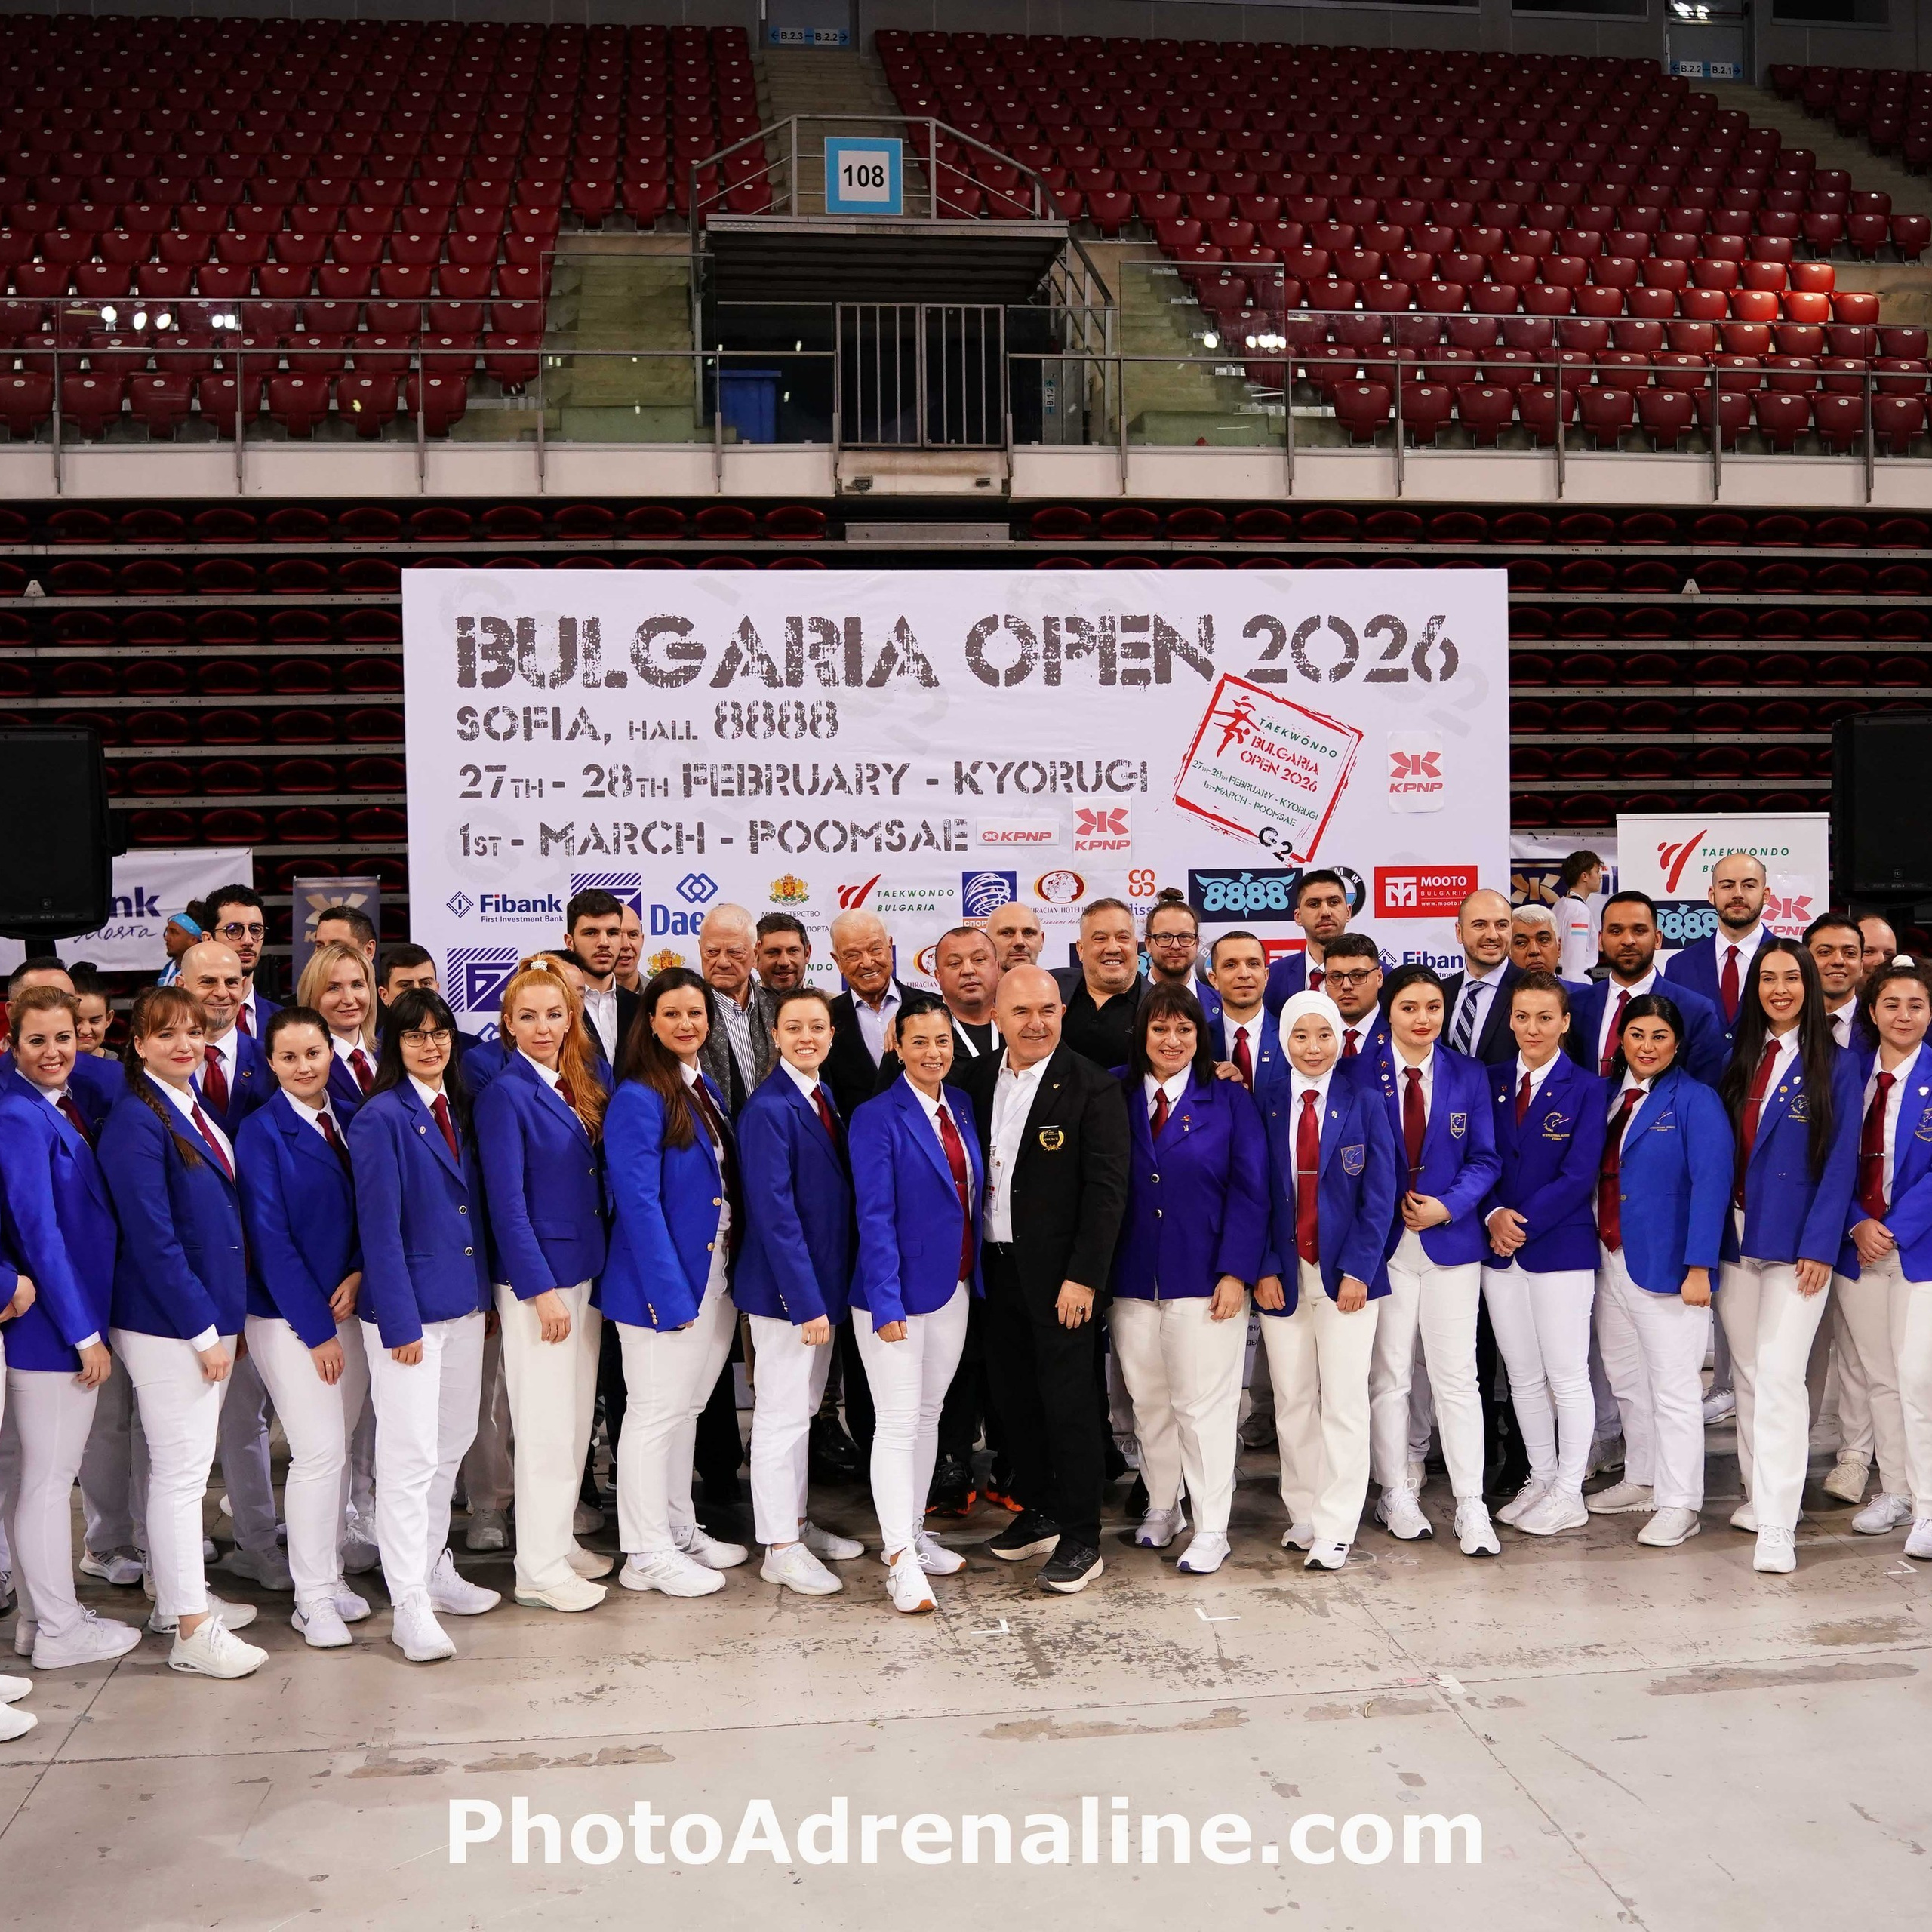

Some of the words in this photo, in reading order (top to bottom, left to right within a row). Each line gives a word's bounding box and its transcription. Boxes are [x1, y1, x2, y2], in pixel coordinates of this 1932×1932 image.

[780, 32, 804, 40] B.2.3
[815, 33, 838, 42] B.2.2
[1681, 65, 1702, 73] B.2.2
[843, 165, 884, 188] 108
[456, 615, 940, 689] BULGARIA
[965, 614, 1216, 688] OPEN
[1242, 614, 1460, 684] 2026
[457, 706, 611, 746] SOFIA,
[629, 720, 698, 740] HALL
[714, 700, 839, 740] 8888
[1259, 718, 1338, 758] TAEKWONDO
[1251, 735, 1319, 775] BULGARIA
[582, 763, 669, 798] 28TH
[682, 762, 911, 798] FEBRUARY
[954, 758, 1148, 795] KYORUGI
[1240, 749, 1281, 776] OPEN
[1281, 768, 1318, 793] 2026
[1227, 775, 1275, 801] FEBRUARY
[1279, 797, 1319, 821] KYORUGI
[1389, 783, 1443, 793] KPNP
[1253, 801, 1297, 827] POOMSAE
[459, 823, 503, 857] 1ST
[540, 821, 706, 857] MARCH
[749, 819, 969, 855] POOMSAE
[1001, 832, 1052, 841] KPNP
[1075, 840, 1131, 851] KPNP
[877, 889, 955, 897] TAEKWONDO
[1420, 875, 1467, 887] MOOTO
[480, 894, 562, 913] Fibank
[1203, 880, 1289, 912] 8888
[500, 915, 544, 923] Investment
[650, 904, 705, 936] Dae
[1403, 951, 1466, 968] Fiban
